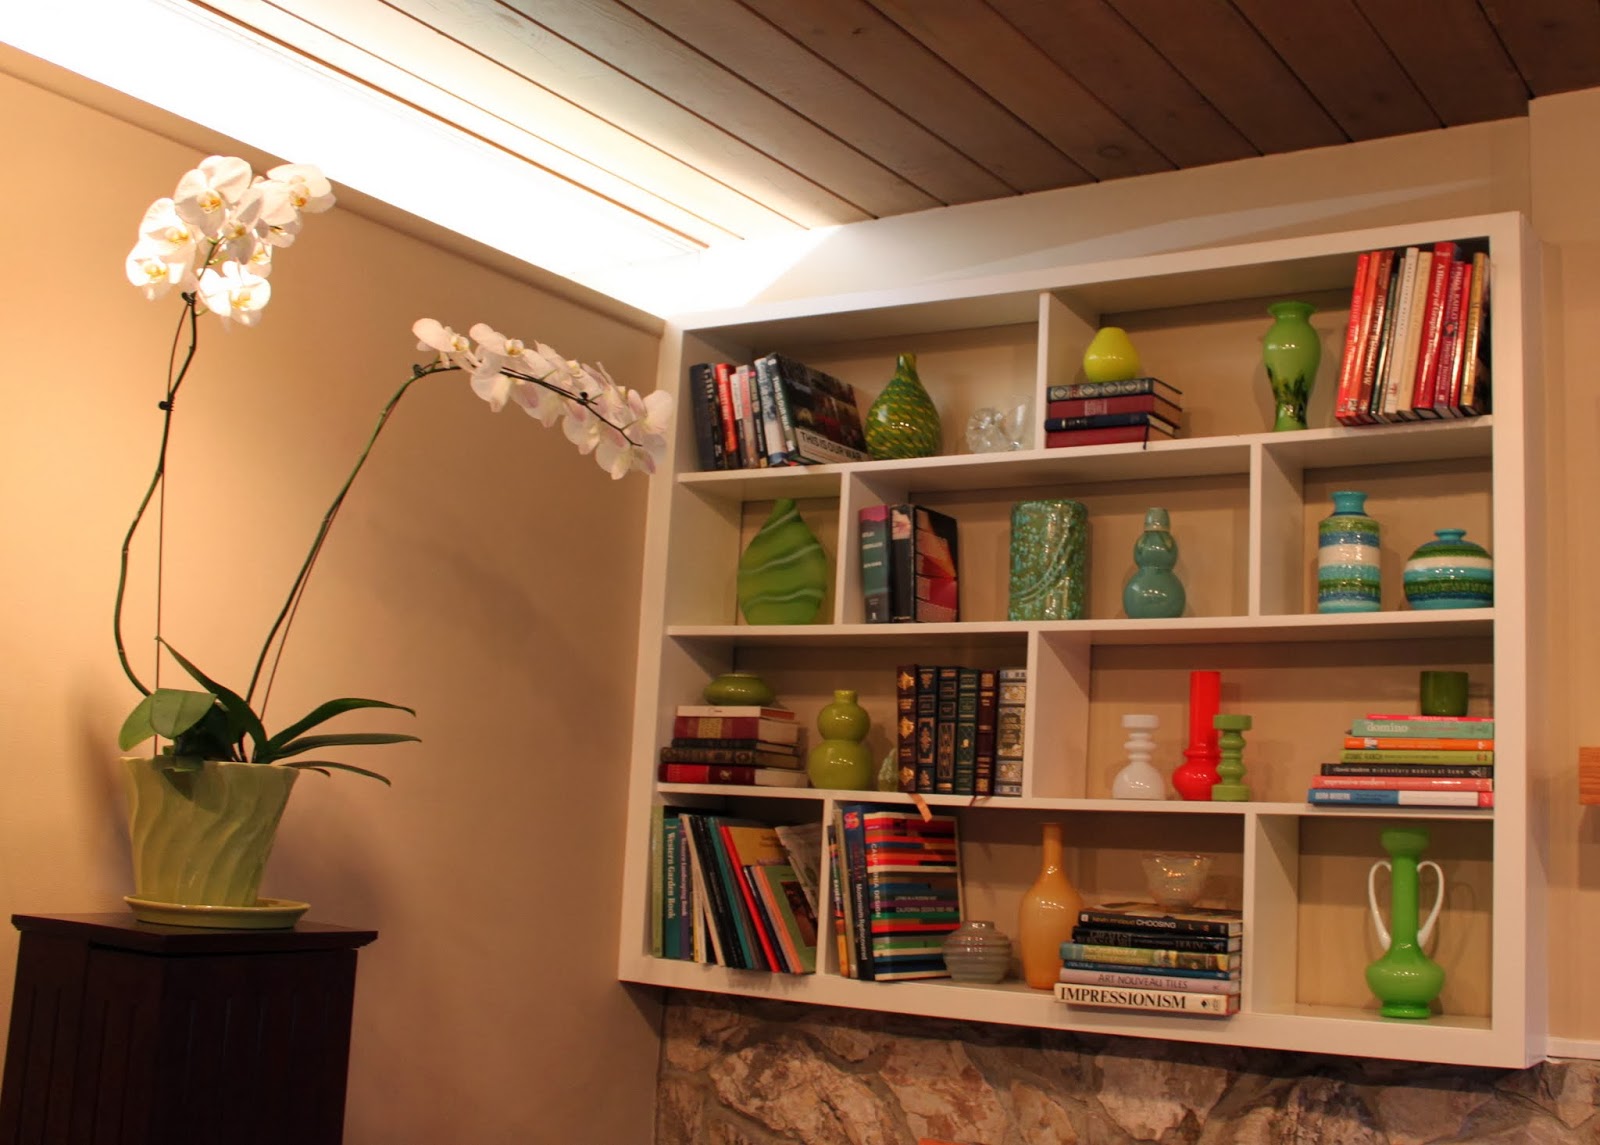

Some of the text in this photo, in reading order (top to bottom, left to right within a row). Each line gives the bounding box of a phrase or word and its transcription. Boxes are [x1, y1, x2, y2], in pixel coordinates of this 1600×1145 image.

[1433, 269, 1445, 298] History
[800, 431, 816, 444] THIS
[826, 441, 843, 454] OUR
[1366, 722, 1408, 733] domino
[667, 832, 676, 919] Western Garden Book
[871, 843, 879, 888] CALIFNIA
[856, 884, 865, 919] Modernism
[1136, 919, 1177, 929] CHOOSING
[857, 920, 868, 960] Rediscovered
[1098, 974, 1188, 989] ART NOUVEAU TILES
[1061, 987, 1186, 1009] IMPRESSIONISM
